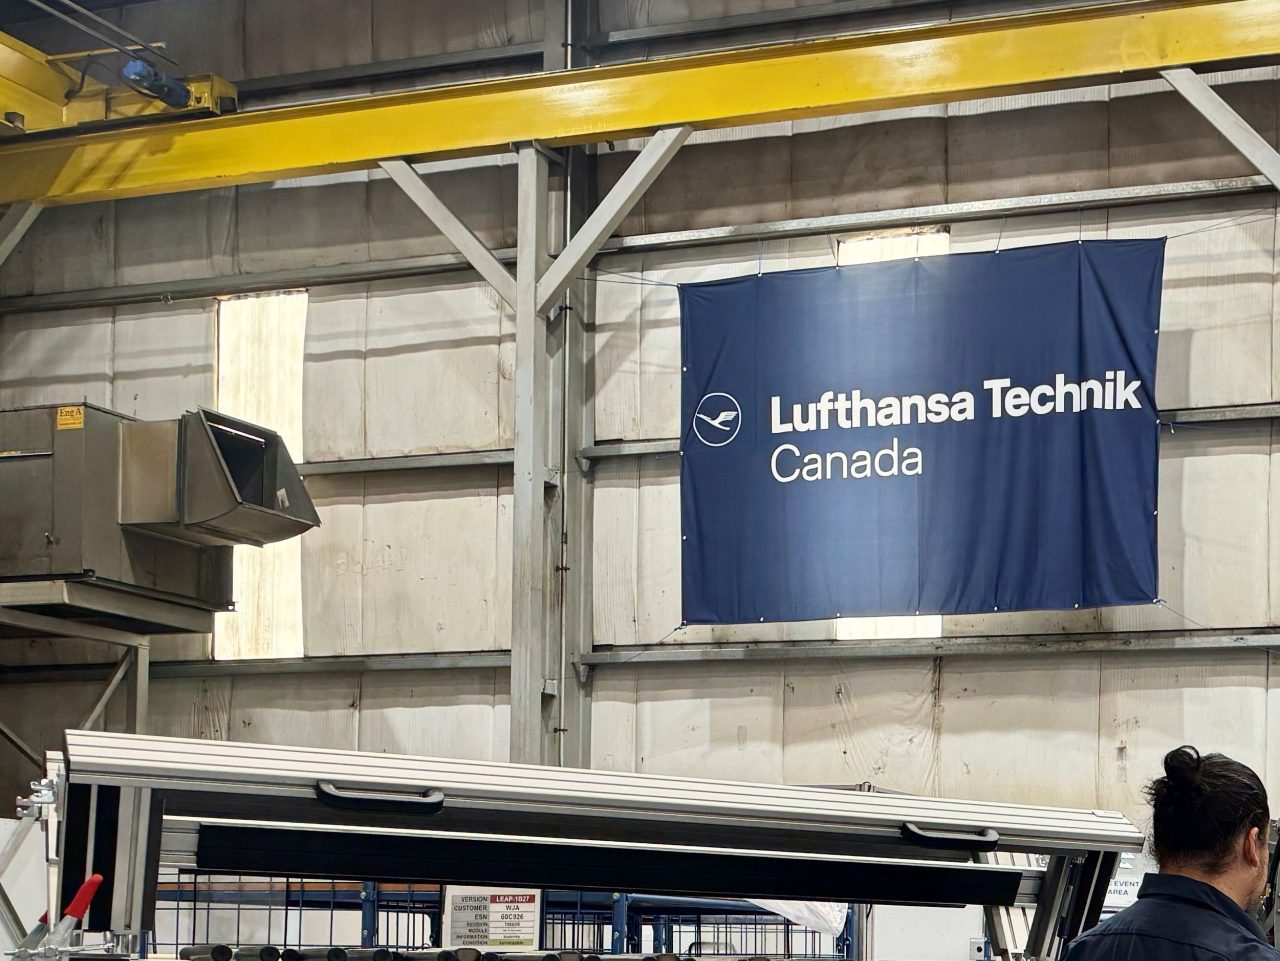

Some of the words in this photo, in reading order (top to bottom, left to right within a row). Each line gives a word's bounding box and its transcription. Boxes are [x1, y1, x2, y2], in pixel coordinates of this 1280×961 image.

[770, 389, 975, 435] Lufthansa
[983, 370, 1143, 418] Technik
[770, 438, 924, 484] Canada
